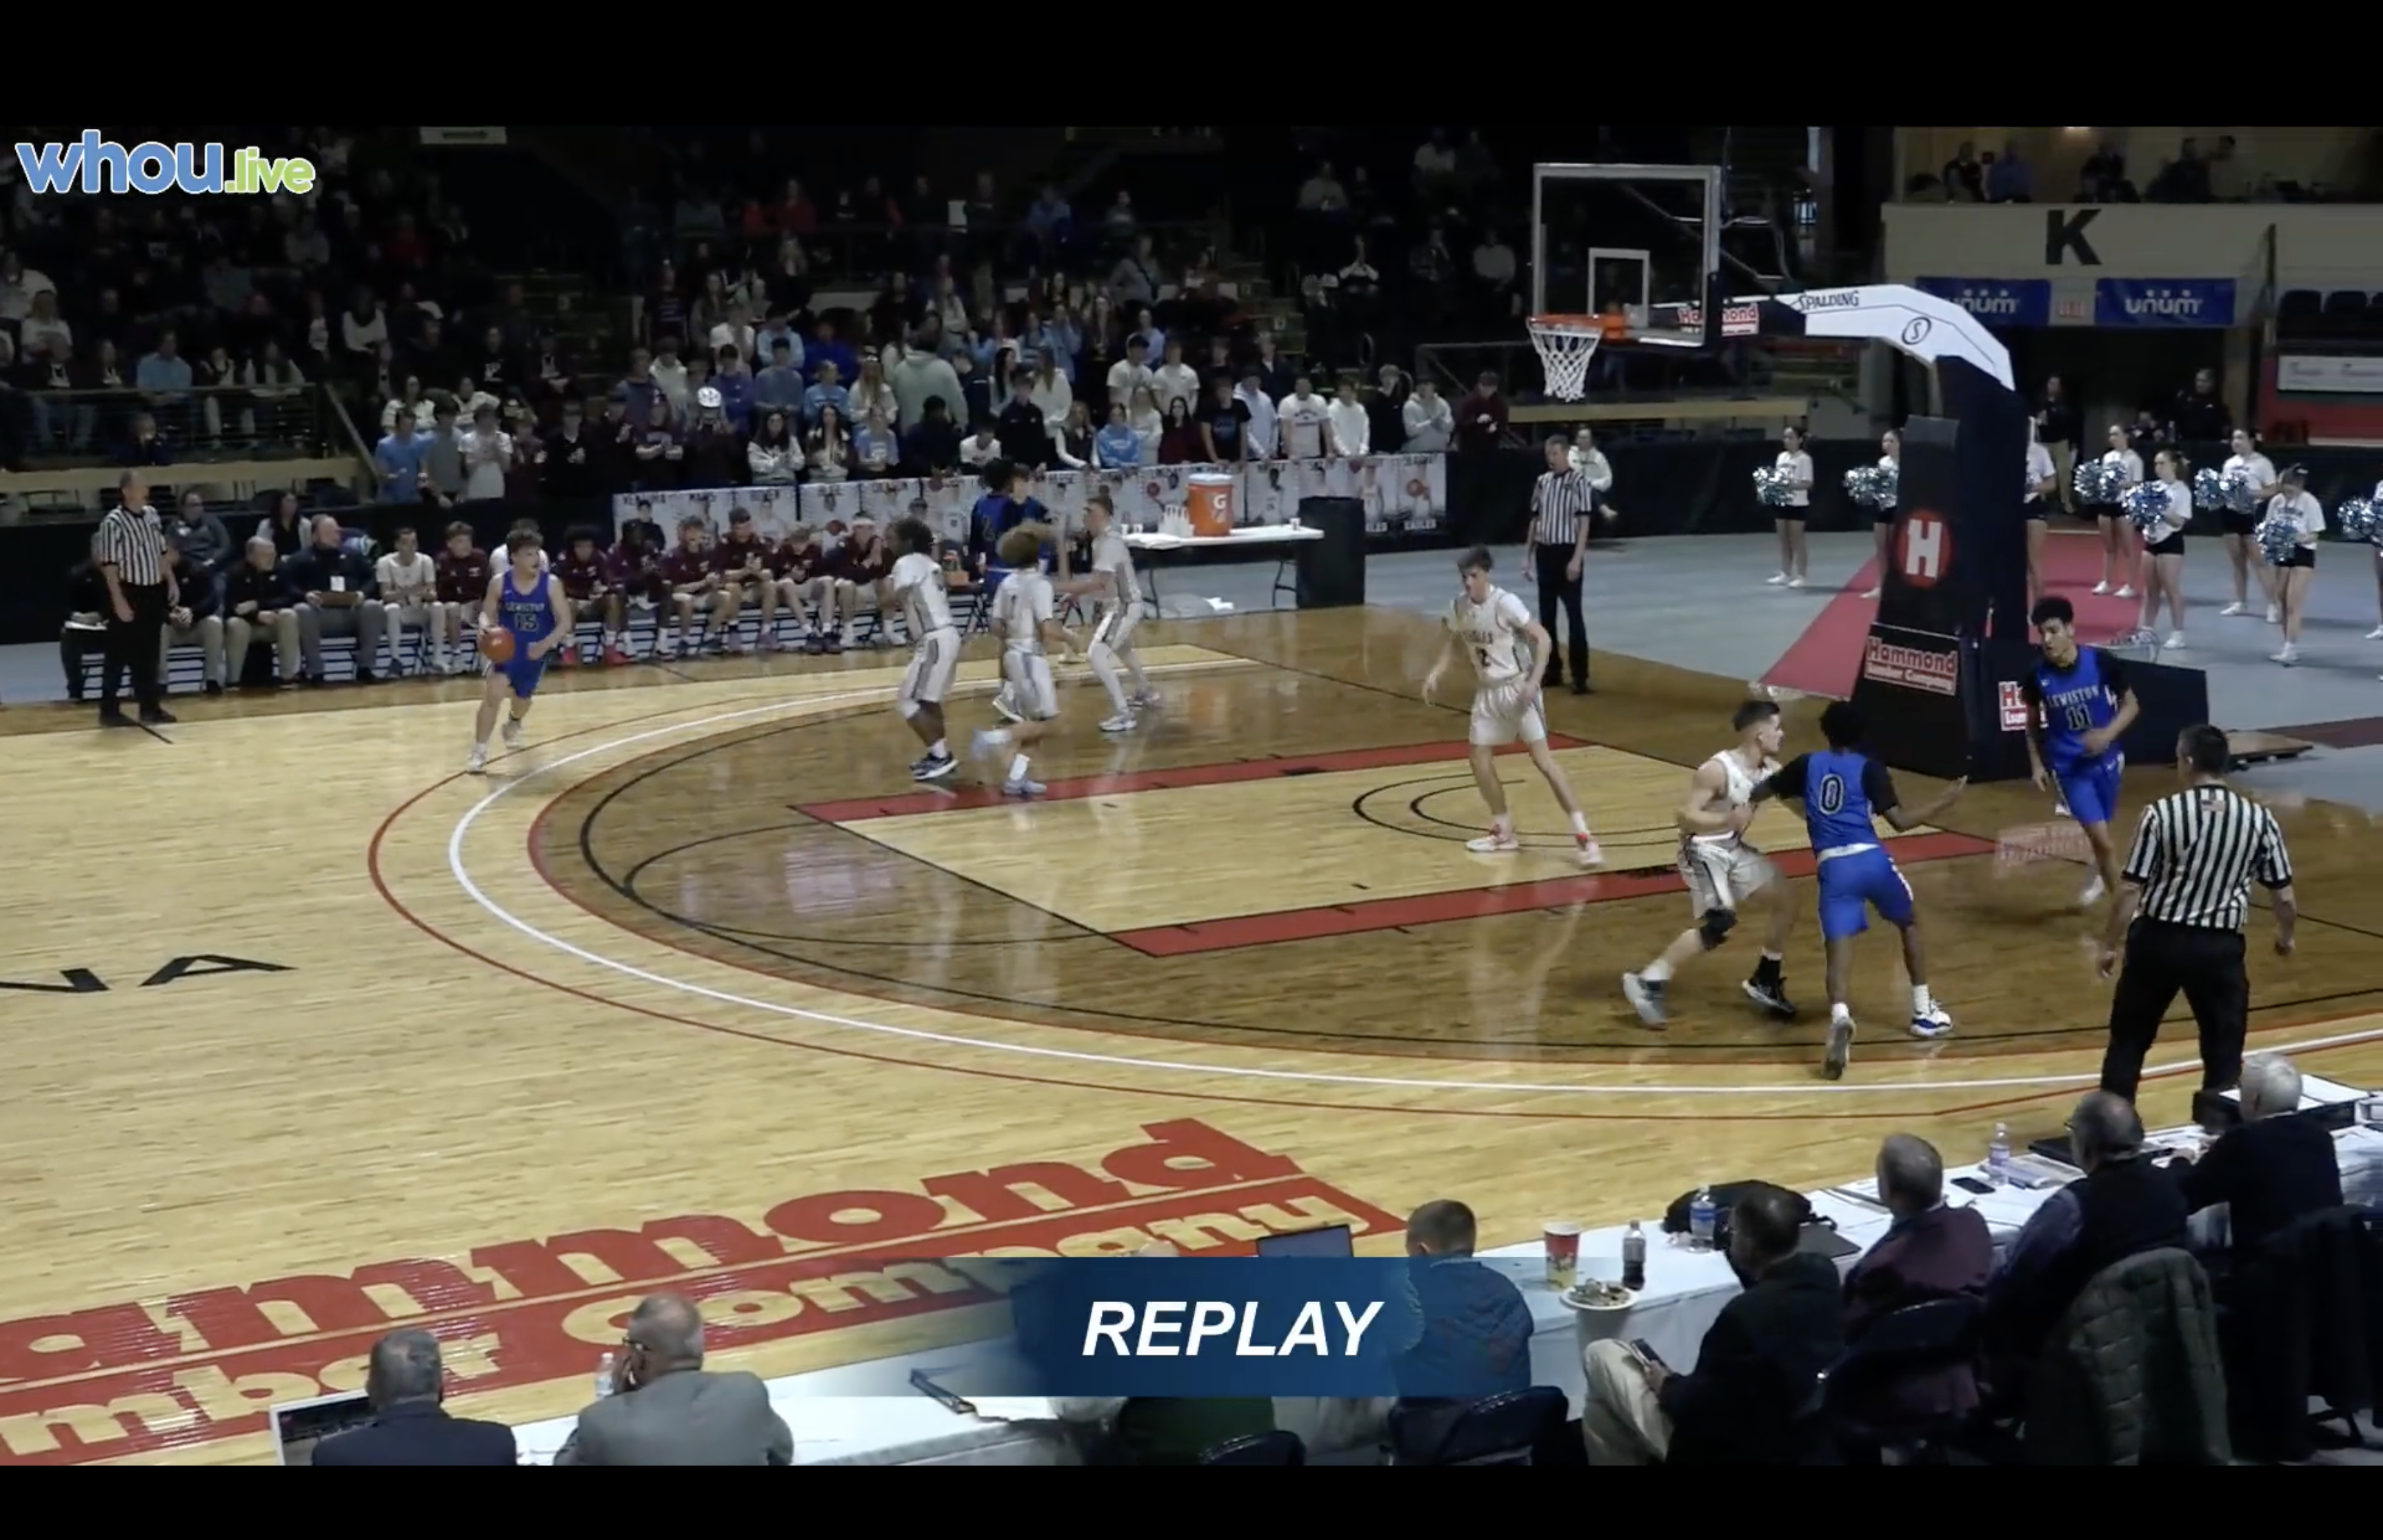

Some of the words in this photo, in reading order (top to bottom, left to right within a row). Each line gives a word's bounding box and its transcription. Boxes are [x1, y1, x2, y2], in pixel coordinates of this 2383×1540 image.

[2045, 209, 2102, 265] K
[1798, 290, 1860, 311] SPALDING
[1212, 493, 1228, 509] G
[1906, 518, 1943, 579] H
[514, 613, 539, 632] 15
[1866, 636, 1958, 673] Hammond
[2047, 685, 2100, 709] LEWISTON
[1820, 774, 1844, 815] 0
